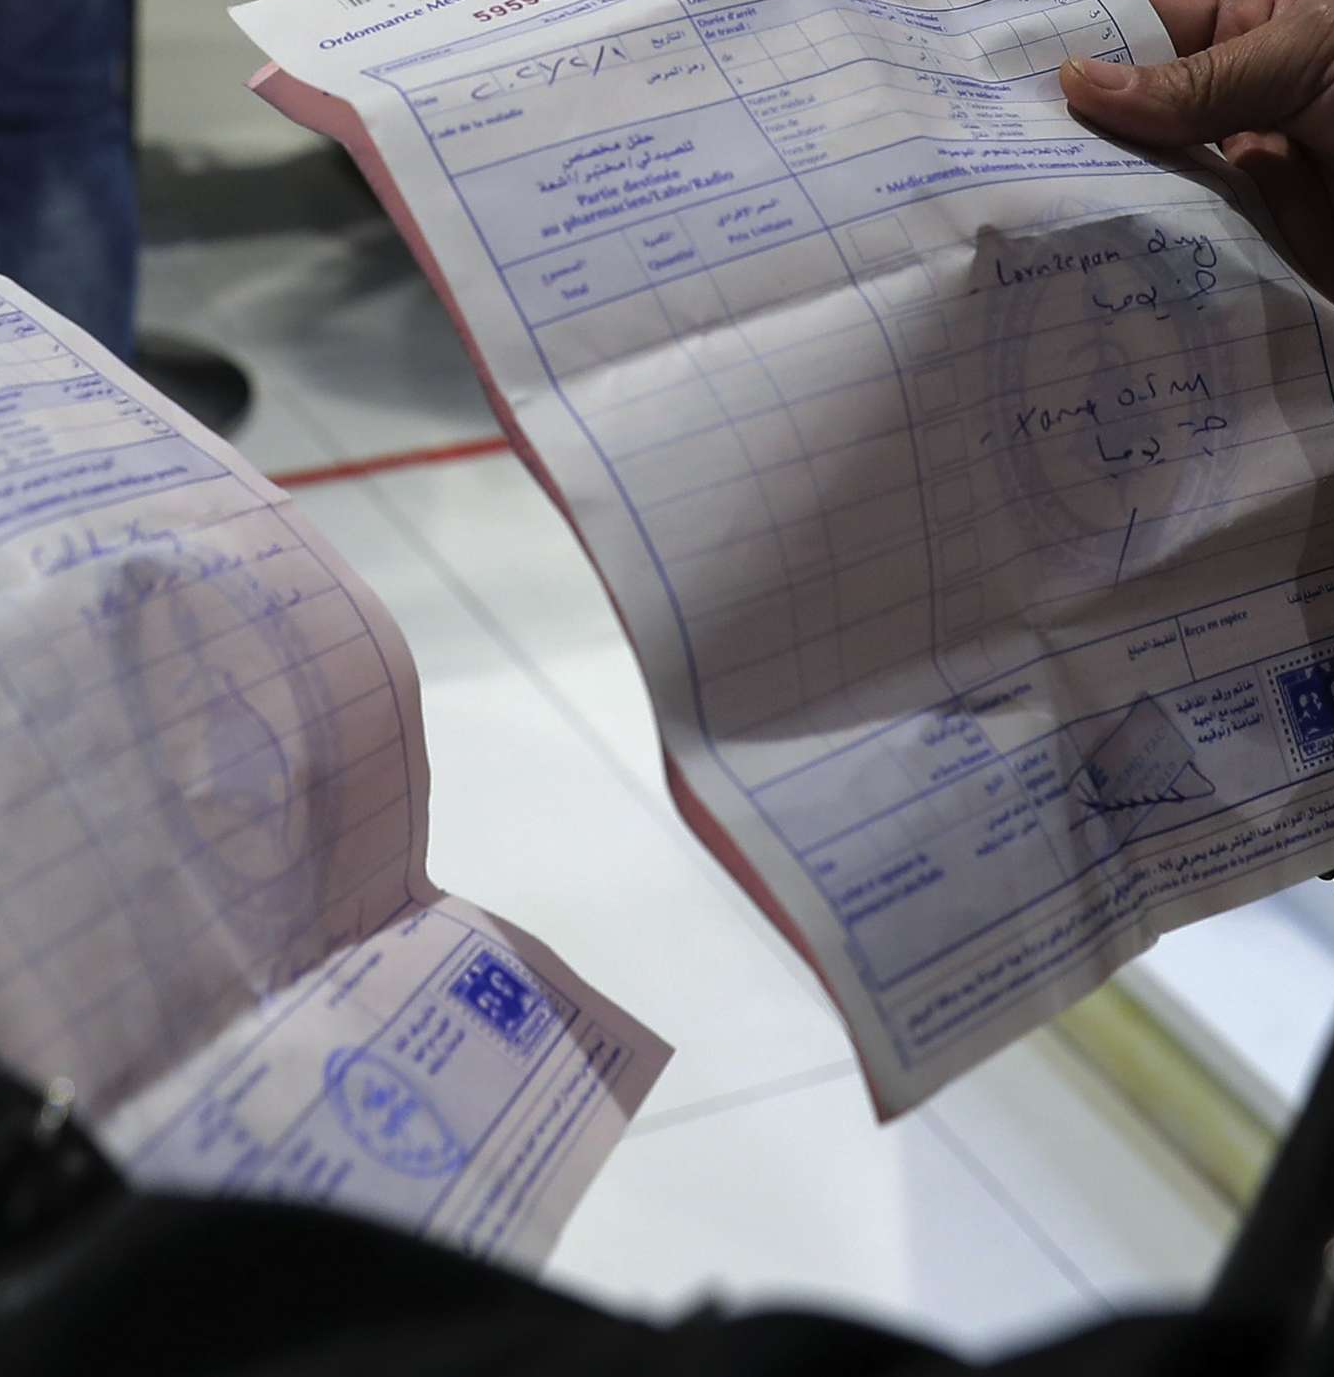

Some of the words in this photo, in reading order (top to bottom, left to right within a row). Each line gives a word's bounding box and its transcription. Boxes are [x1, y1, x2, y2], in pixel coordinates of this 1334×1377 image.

[319, 7, 425, 51] Ordonnance
[697, 14, 725, 28] Durée
[717, 23, 746, 37] travail
[1100, 26, 1116, 41] إلى
[650, 30, 686, 49] التاريخ
[646, 66, 685, 84] المرض
[685, 62, 706, 76] رمز
[627, 134, 654, 151] حقل
[576, 187, 619, 207] Partie
[622, 169, 681, 194] destinée
[541, 224, 561, 238] au
[1184, 621, 1206, 639] Reçu
